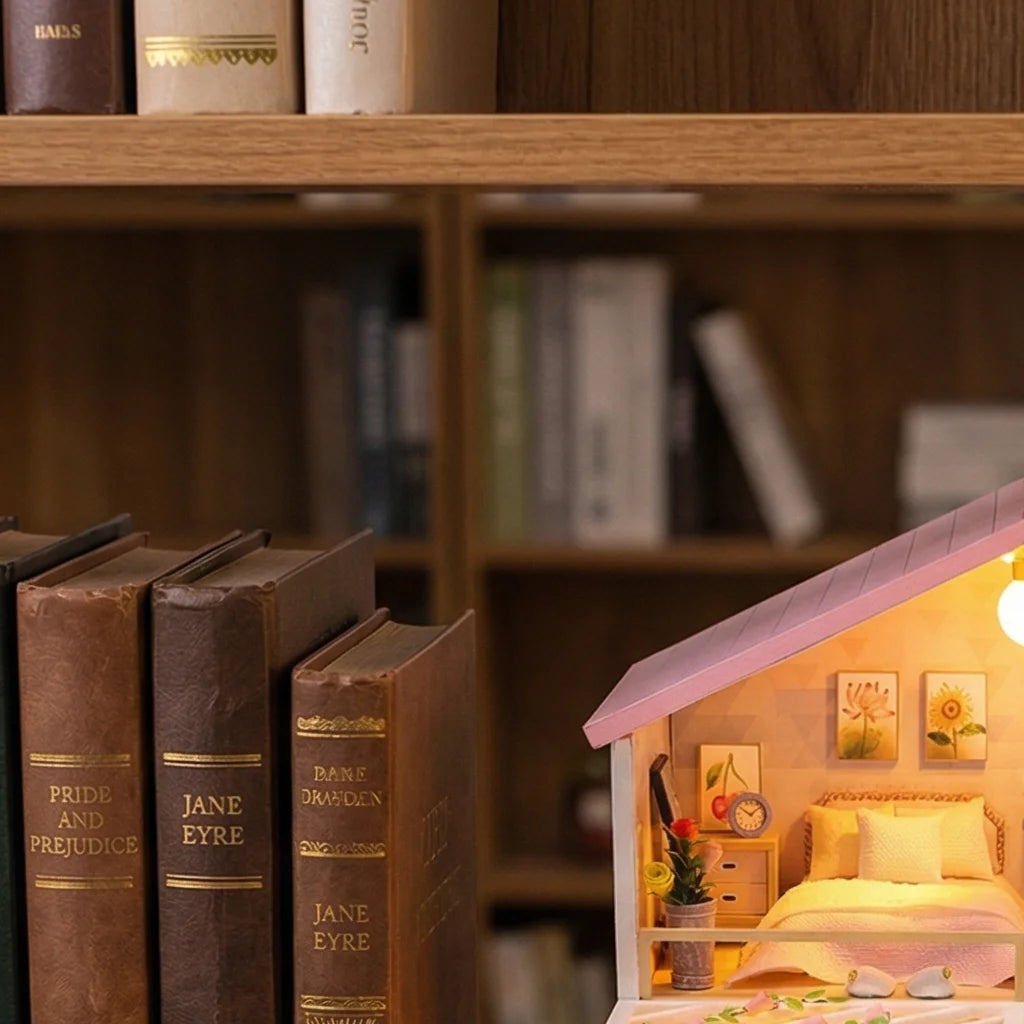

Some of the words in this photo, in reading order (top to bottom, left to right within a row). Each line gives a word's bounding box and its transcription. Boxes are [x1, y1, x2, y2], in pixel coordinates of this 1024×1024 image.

[49, 785, 113, 804] PRIDE
[181, 793, 243, 819] JANE
[57, 810, 105, 830] AND
[181, 824, 245, 846] EYRE
[30, 835, 139, 858] PREJUDICE
[312, 903, 371, 926] JANE
[313, 931, 371, 952] EYRE
